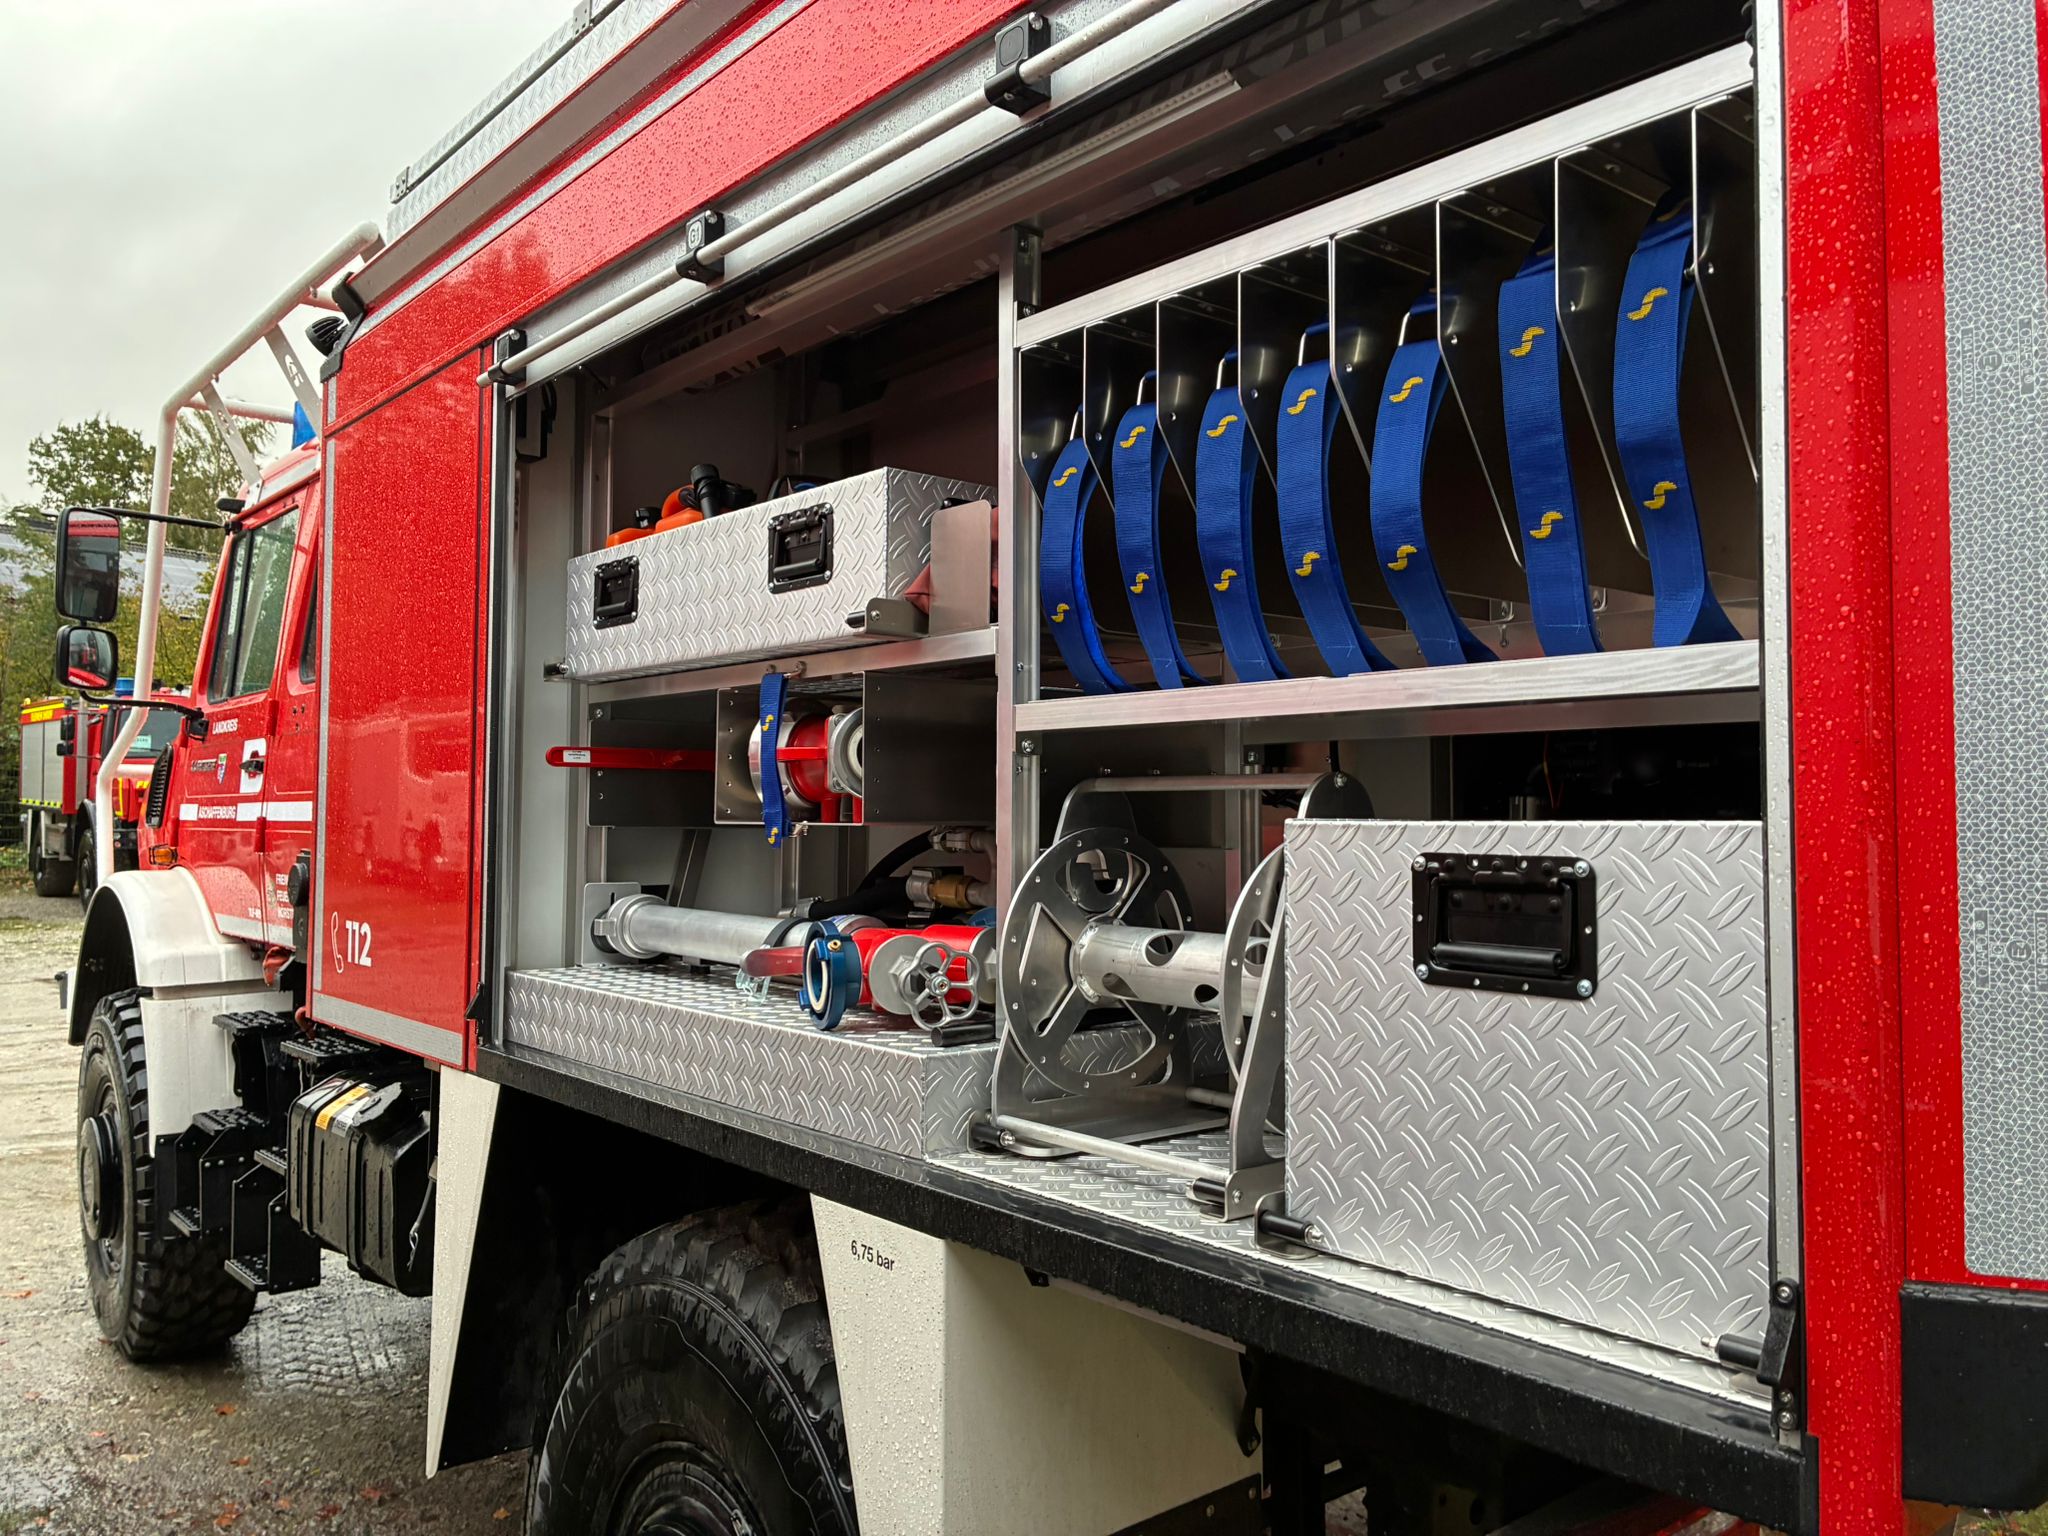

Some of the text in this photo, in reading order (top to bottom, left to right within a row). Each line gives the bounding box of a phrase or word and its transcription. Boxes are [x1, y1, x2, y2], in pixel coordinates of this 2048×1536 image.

[689, 227, 700, 244] G1
[345, 919, 372, 967] 112
[851, 1239, 895, 1271] 6,75 bar
